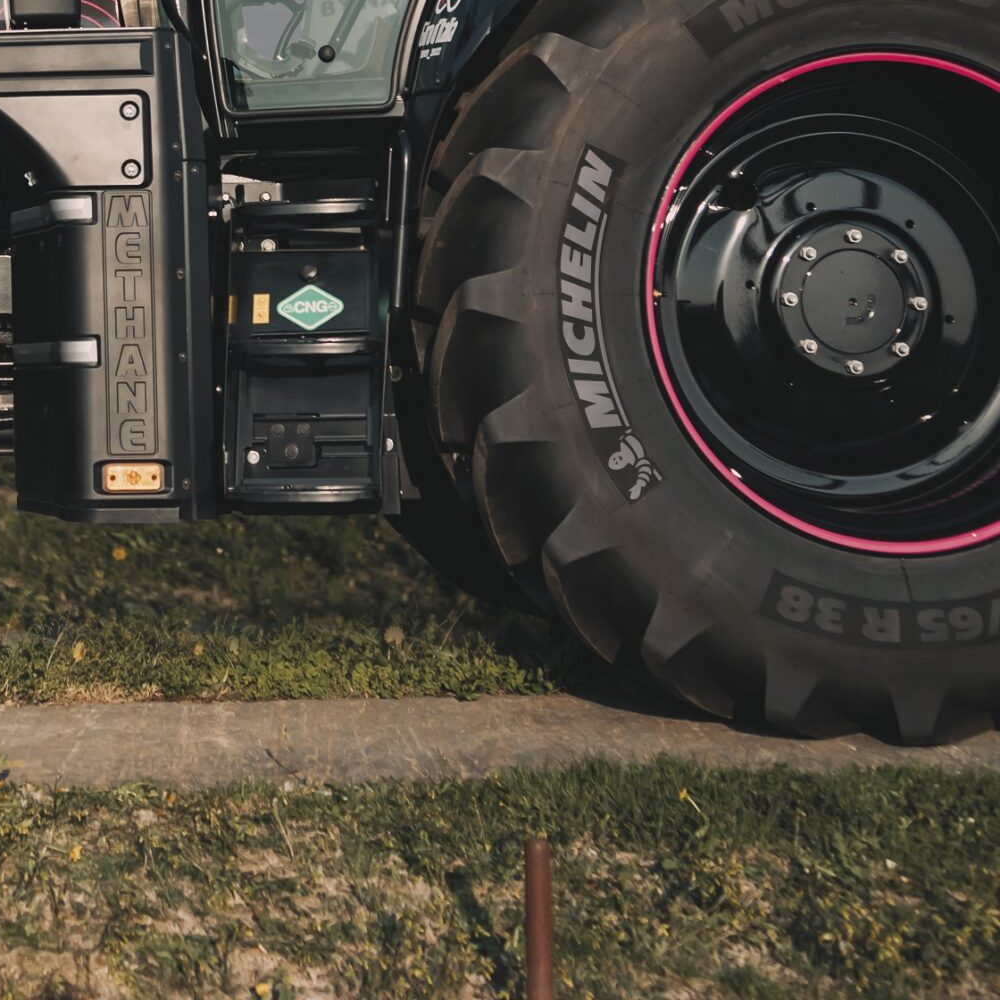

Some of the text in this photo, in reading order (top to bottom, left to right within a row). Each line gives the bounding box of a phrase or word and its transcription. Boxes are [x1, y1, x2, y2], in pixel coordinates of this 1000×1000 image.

[294, 300, 328, 314] CNG
[559, 147, 616, 430] MICHELIN
[105, 193, 150, 453] METHANE
[775, 584, 847, 635] 38
[861, 605, 901, 643] R
